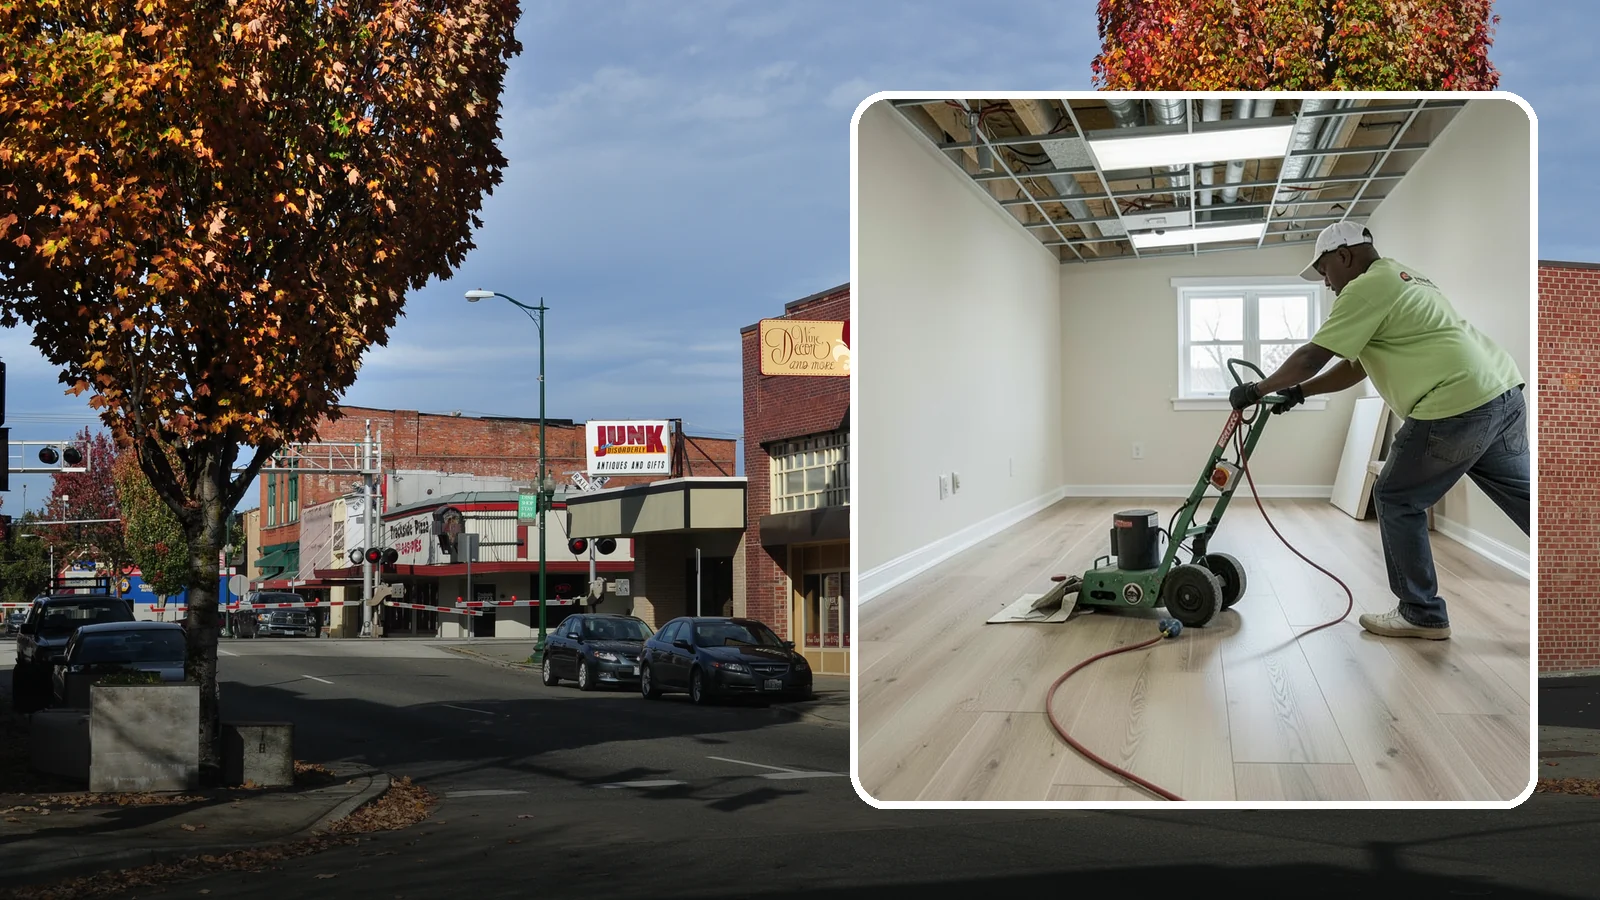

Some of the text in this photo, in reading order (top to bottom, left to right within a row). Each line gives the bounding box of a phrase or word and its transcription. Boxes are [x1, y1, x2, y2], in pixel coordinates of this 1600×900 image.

[595, 425, 665, 457] JUNK
[607, 446, 645, 454] DISORDERLY
[597, 460, 665, 470] ANTIQUES AND GIFTS
[390, 520, 429, 540] Trackside Pizza
